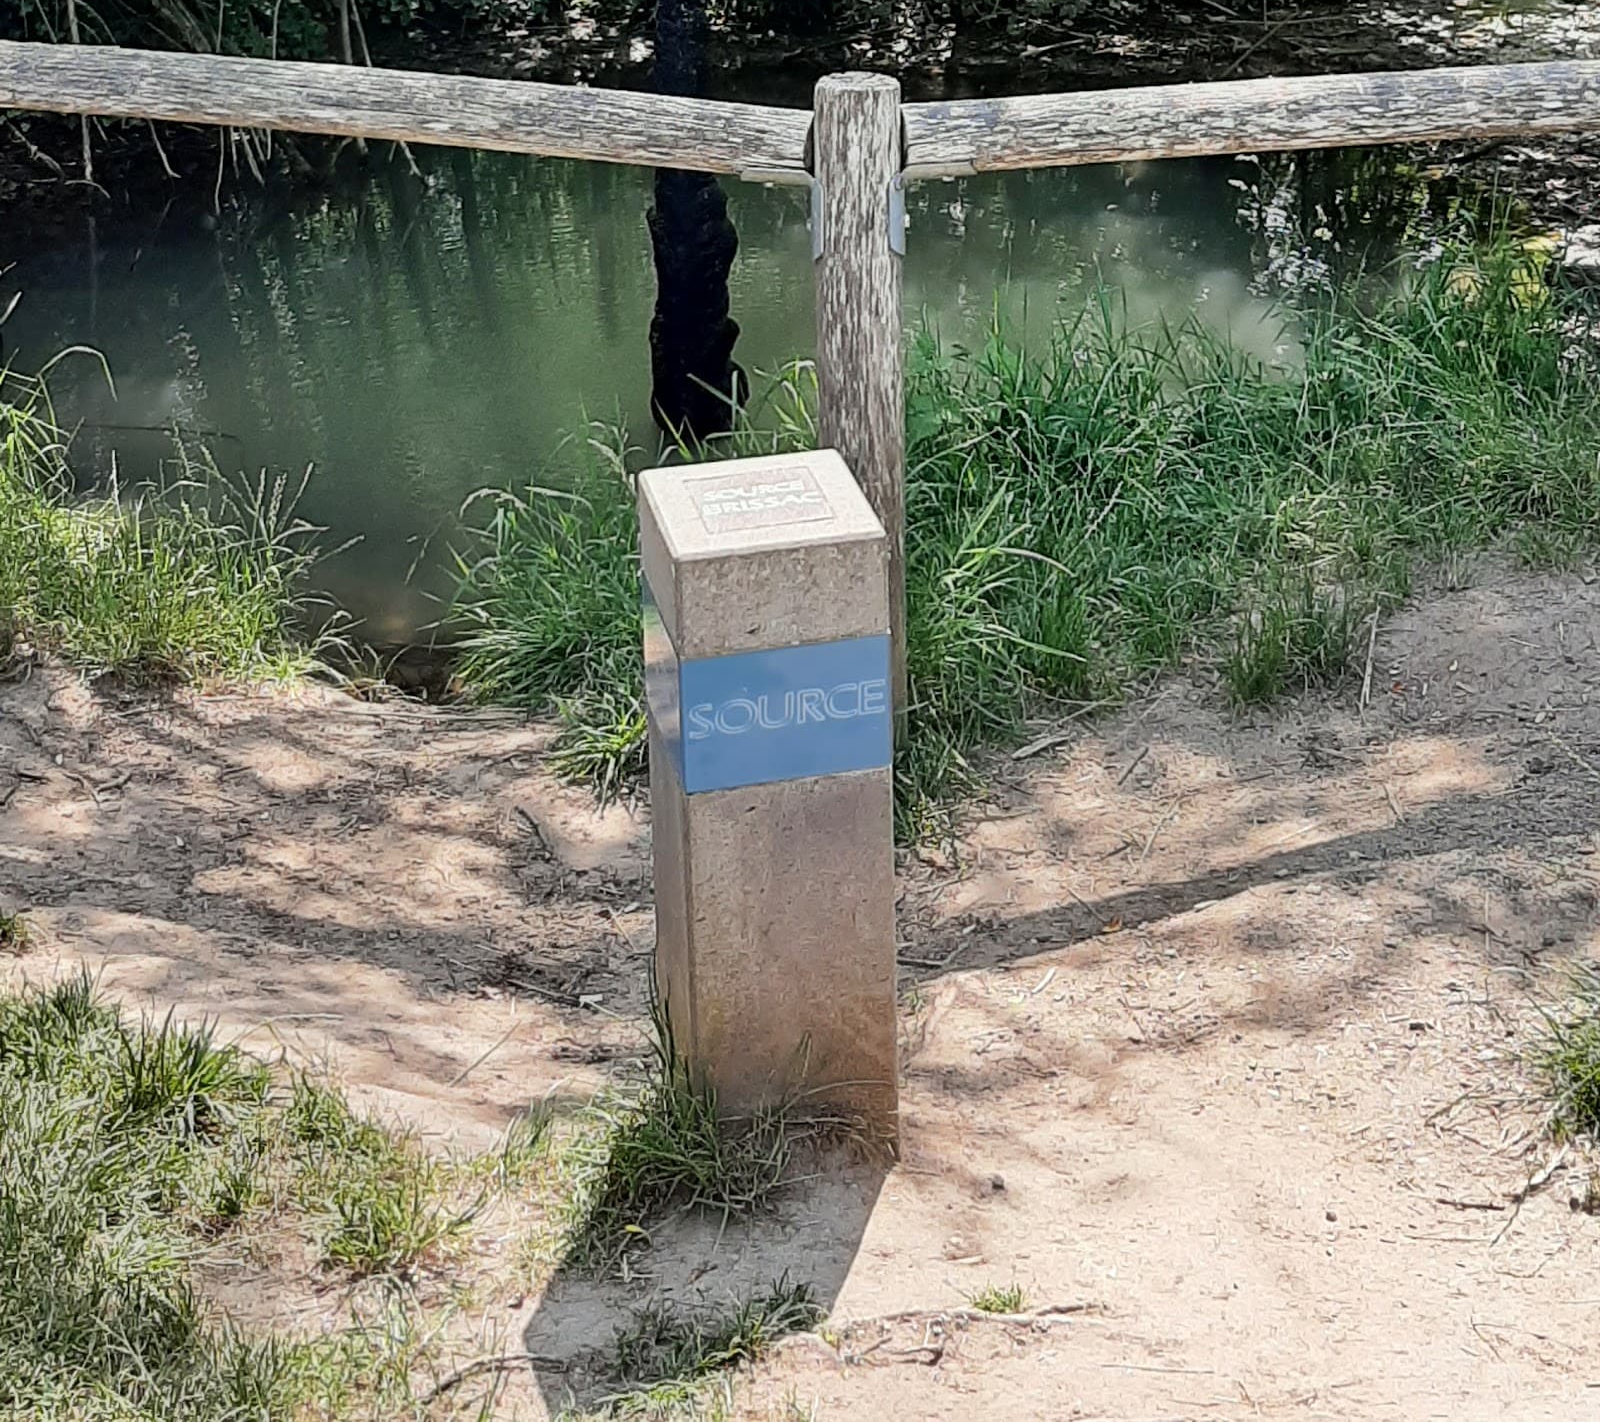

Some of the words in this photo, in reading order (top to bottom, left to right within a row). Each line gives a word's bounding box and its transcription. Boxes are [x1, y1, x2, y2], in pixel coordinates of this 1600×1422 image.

[701, 491, 823, 515] BRISSAC
[703, 480, 804, 502] SOURCE
[688, 678, 886, 740] SOURCE
